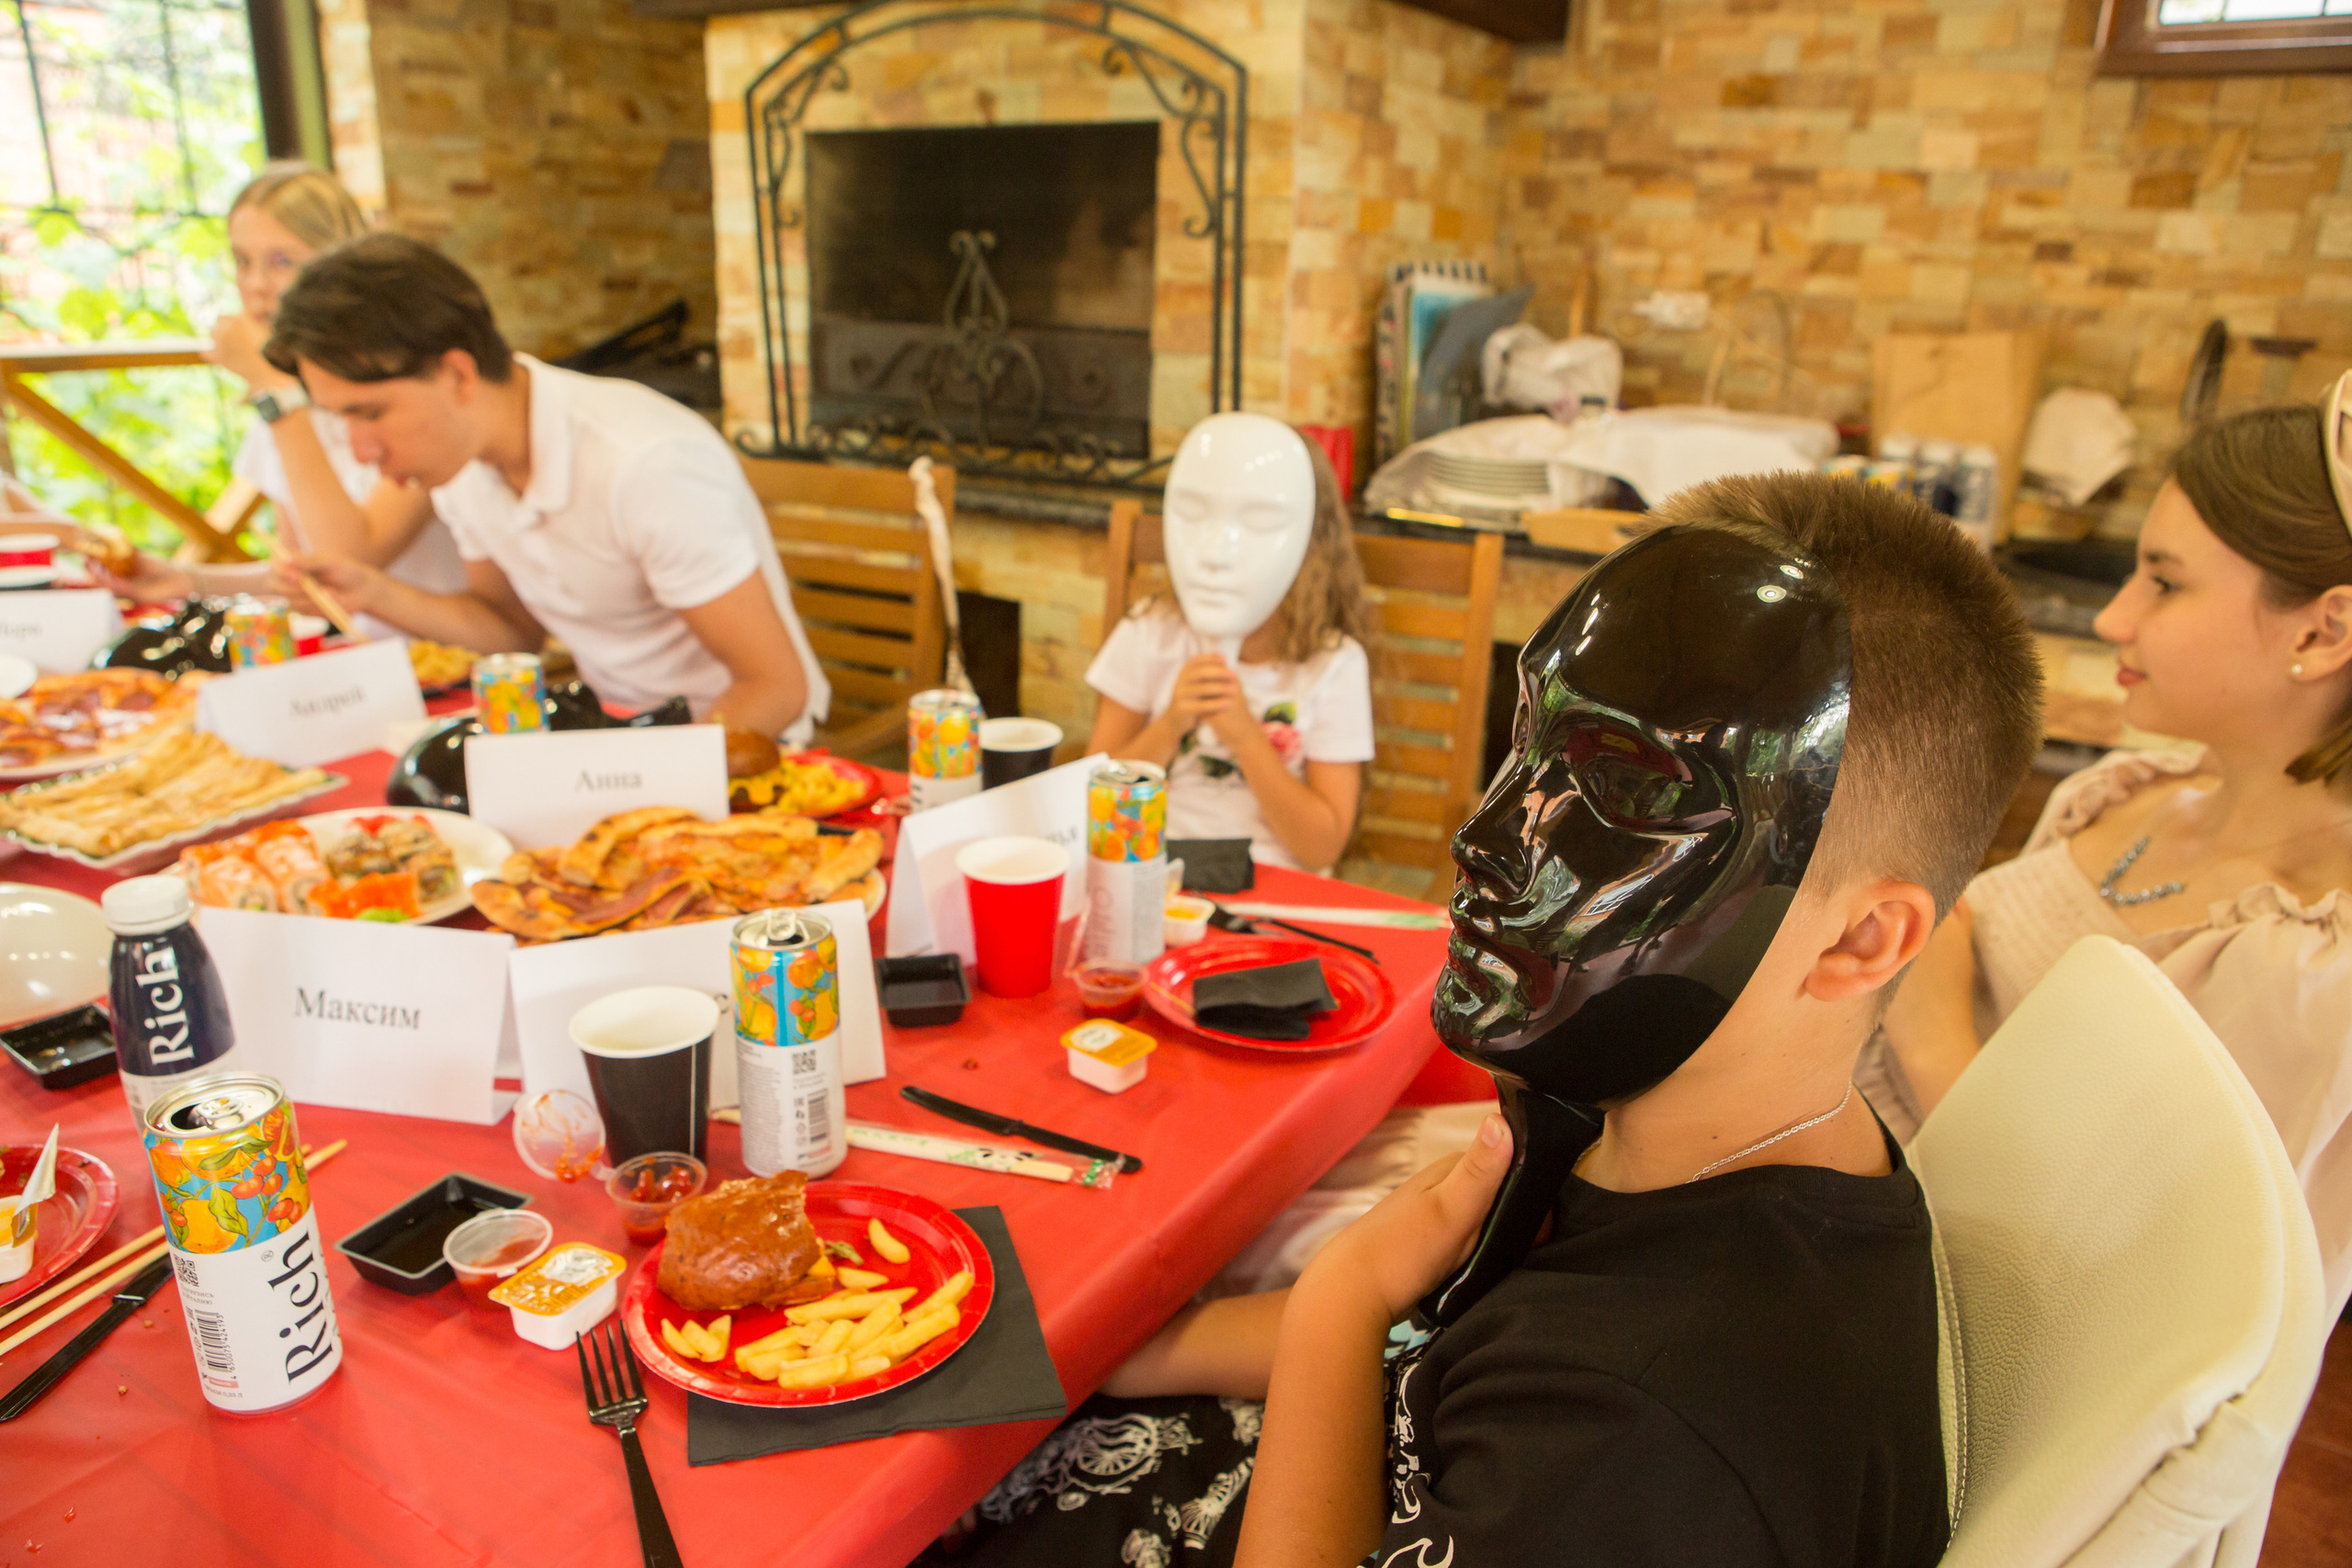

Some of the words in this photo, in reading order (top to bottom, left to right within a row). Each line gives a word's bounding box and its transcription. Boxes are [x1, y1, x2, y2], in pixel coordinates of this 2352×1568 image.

[574, 769, 643, 792] Анна
[135, 946, 195, 1066] Rich
[295, 986, 421, 1030] Максим
[267, 1229, 333, 1386] Rich
